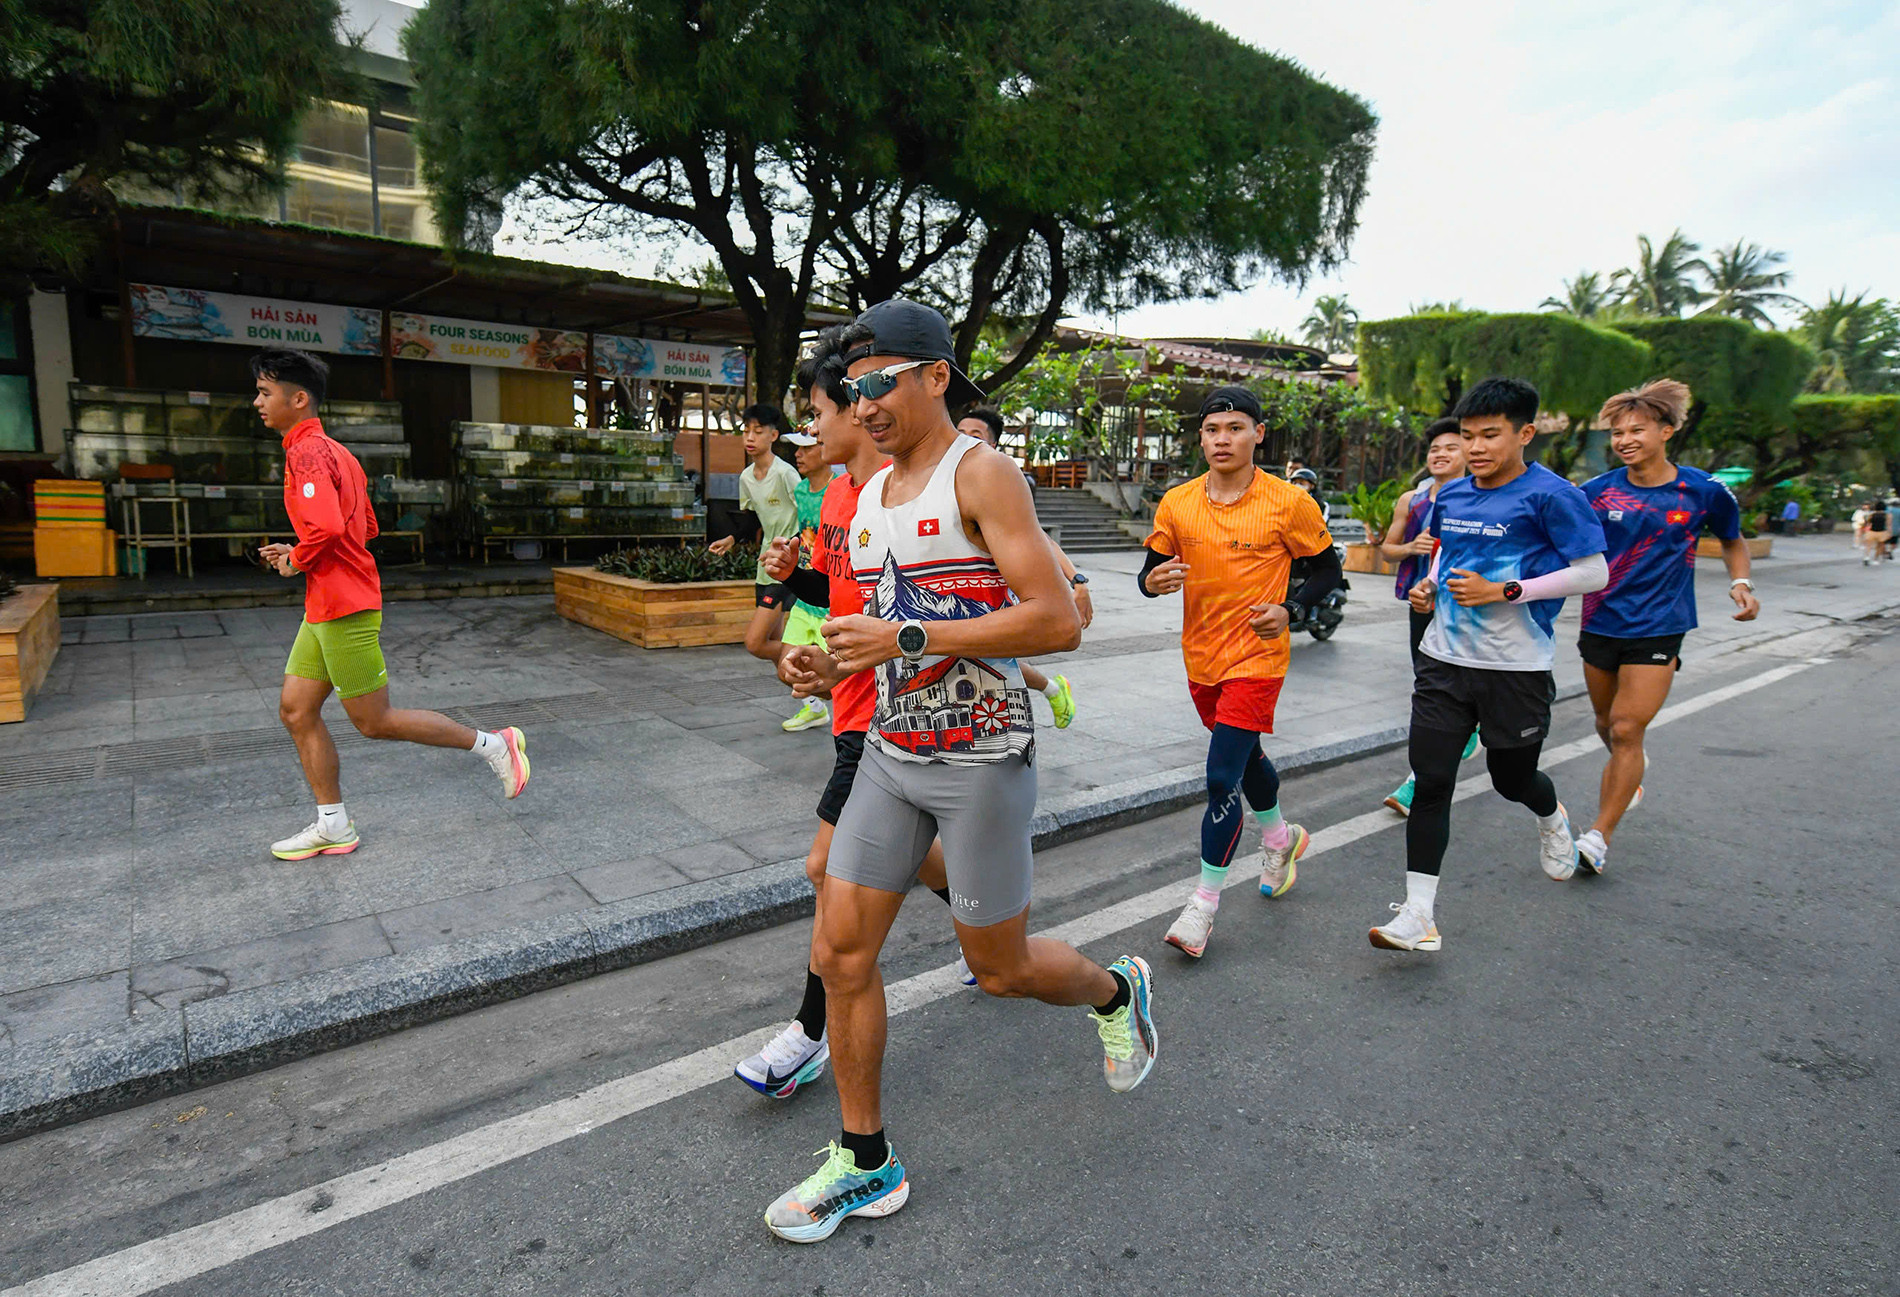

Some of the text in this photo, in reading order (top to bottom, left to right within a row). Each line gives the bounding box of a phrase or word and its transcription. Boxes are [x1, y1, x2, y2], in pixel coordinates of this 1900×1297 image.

[251, 305, 317, 325] HẢI SẢN
[247, 323, 323, 344] BỐN MÙA
[429, 324, 529, 345] FOUR SEASONS
[450, 343, 511, 359] SEAFOOD
[664, 363, 712, 378] BỐN MÙA
[807, 1177, 885, 1228] NITRO
